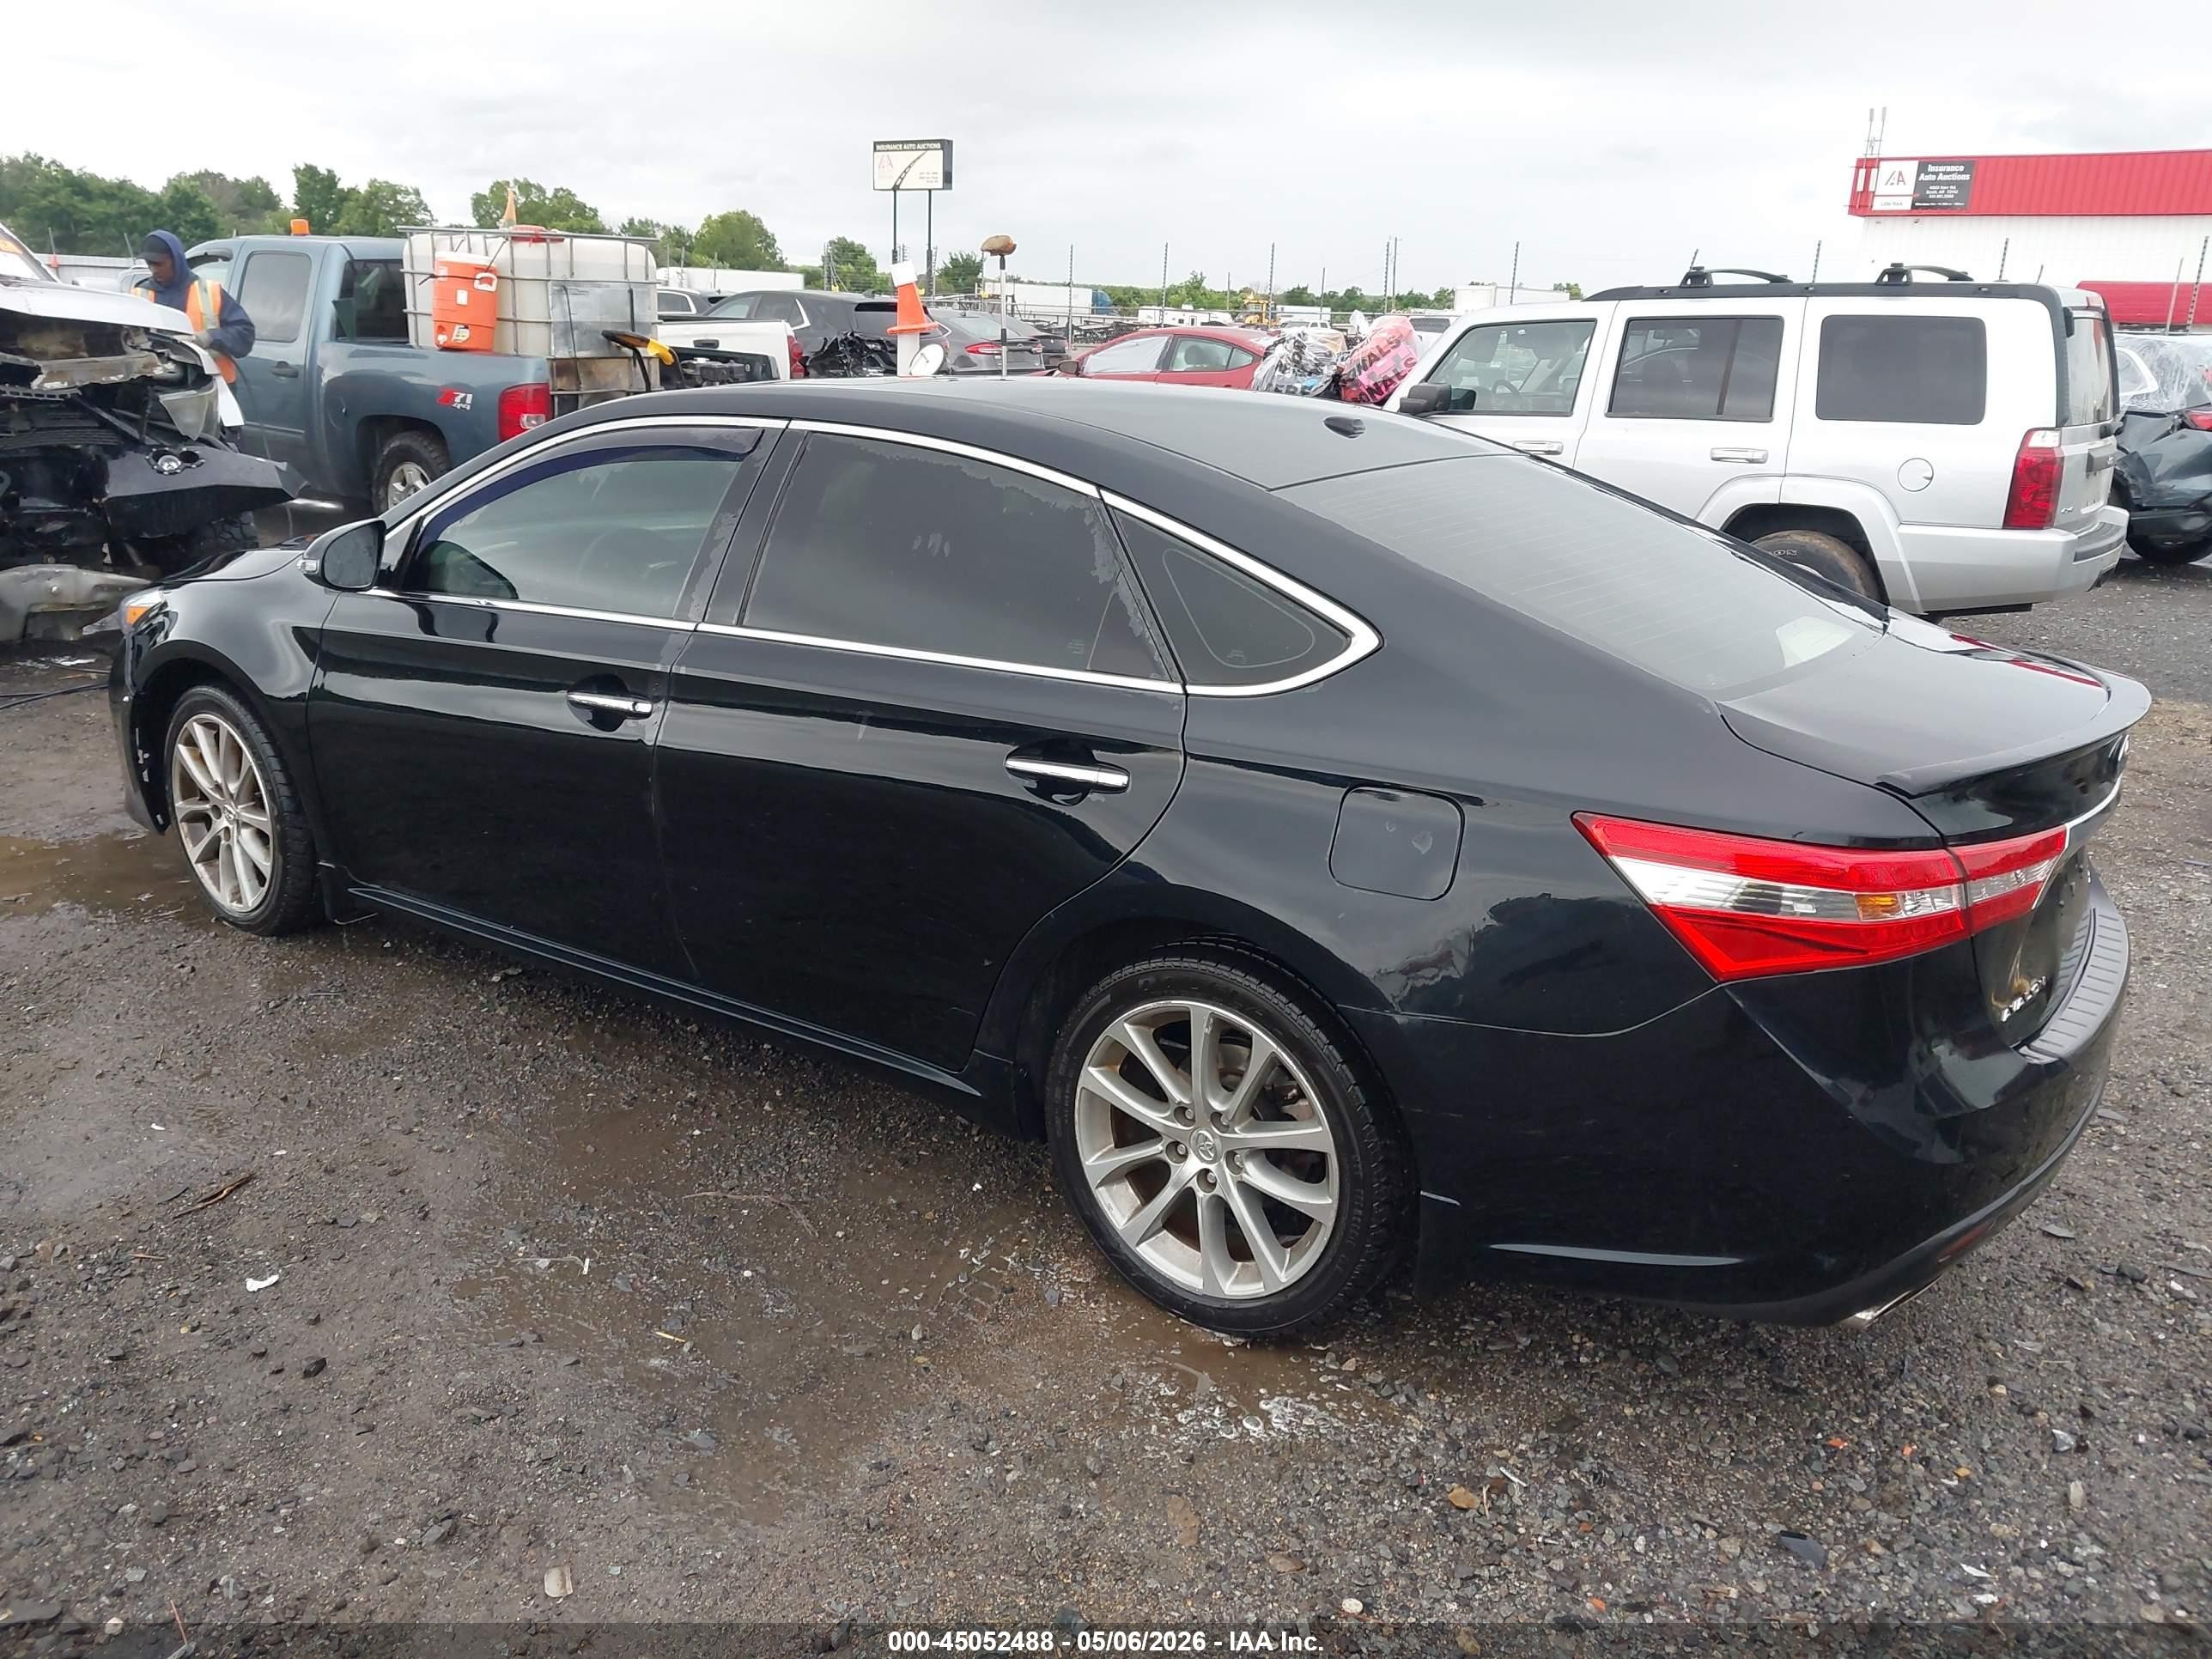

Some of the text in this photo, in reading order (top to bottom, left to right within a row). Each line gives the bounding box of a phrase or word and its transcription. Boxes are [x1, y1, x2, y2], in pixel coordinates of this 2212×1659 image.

[1927, 164, 1965, 173] Insurance
[1918, 172, 1971, 181] Auto Auctions
